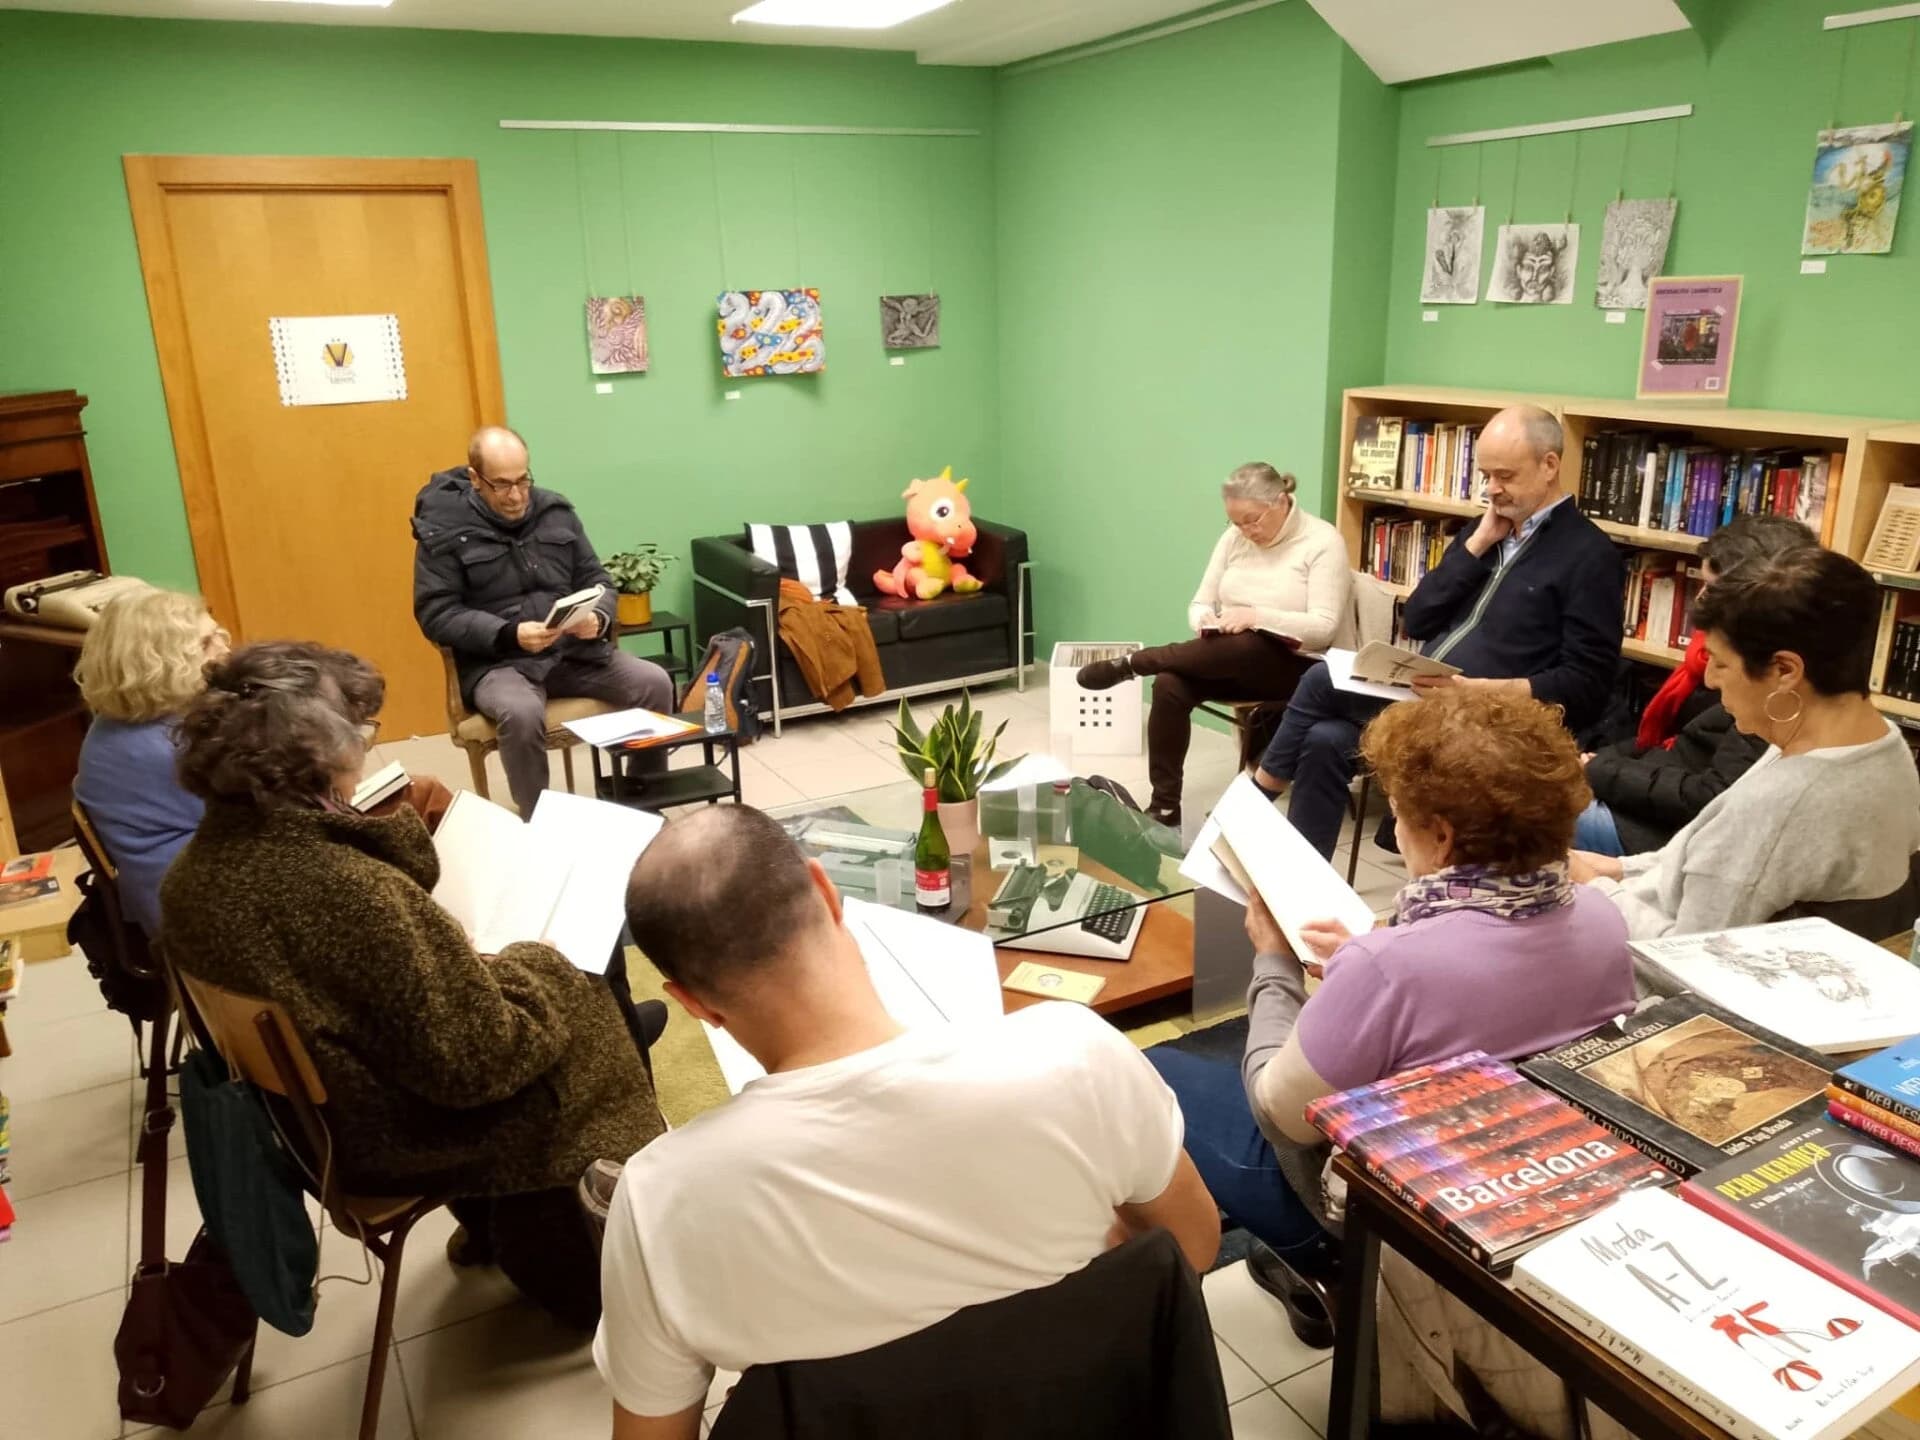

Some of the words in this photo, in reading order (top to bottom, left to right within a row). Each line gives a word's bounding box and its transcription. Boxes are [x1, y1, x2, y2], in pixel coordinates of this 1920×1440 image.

[1562, 1057, 1583, 1070] DE
[1577, 1051, 1598, 1063] LA
[1865, 1089, 1891, 1109] WEB
[1862, 1119, 1888, 1140] WEB
[1365, 1161, 1422, 1212] Barcelona
[1437, 1140, 1616, 1213] Barcelona
[1714, 1173, 1769, 1201] PERO
[1580, 1222, 1654, 1267] Moda
[1625, 1241, 1729, 1313] A-Z
